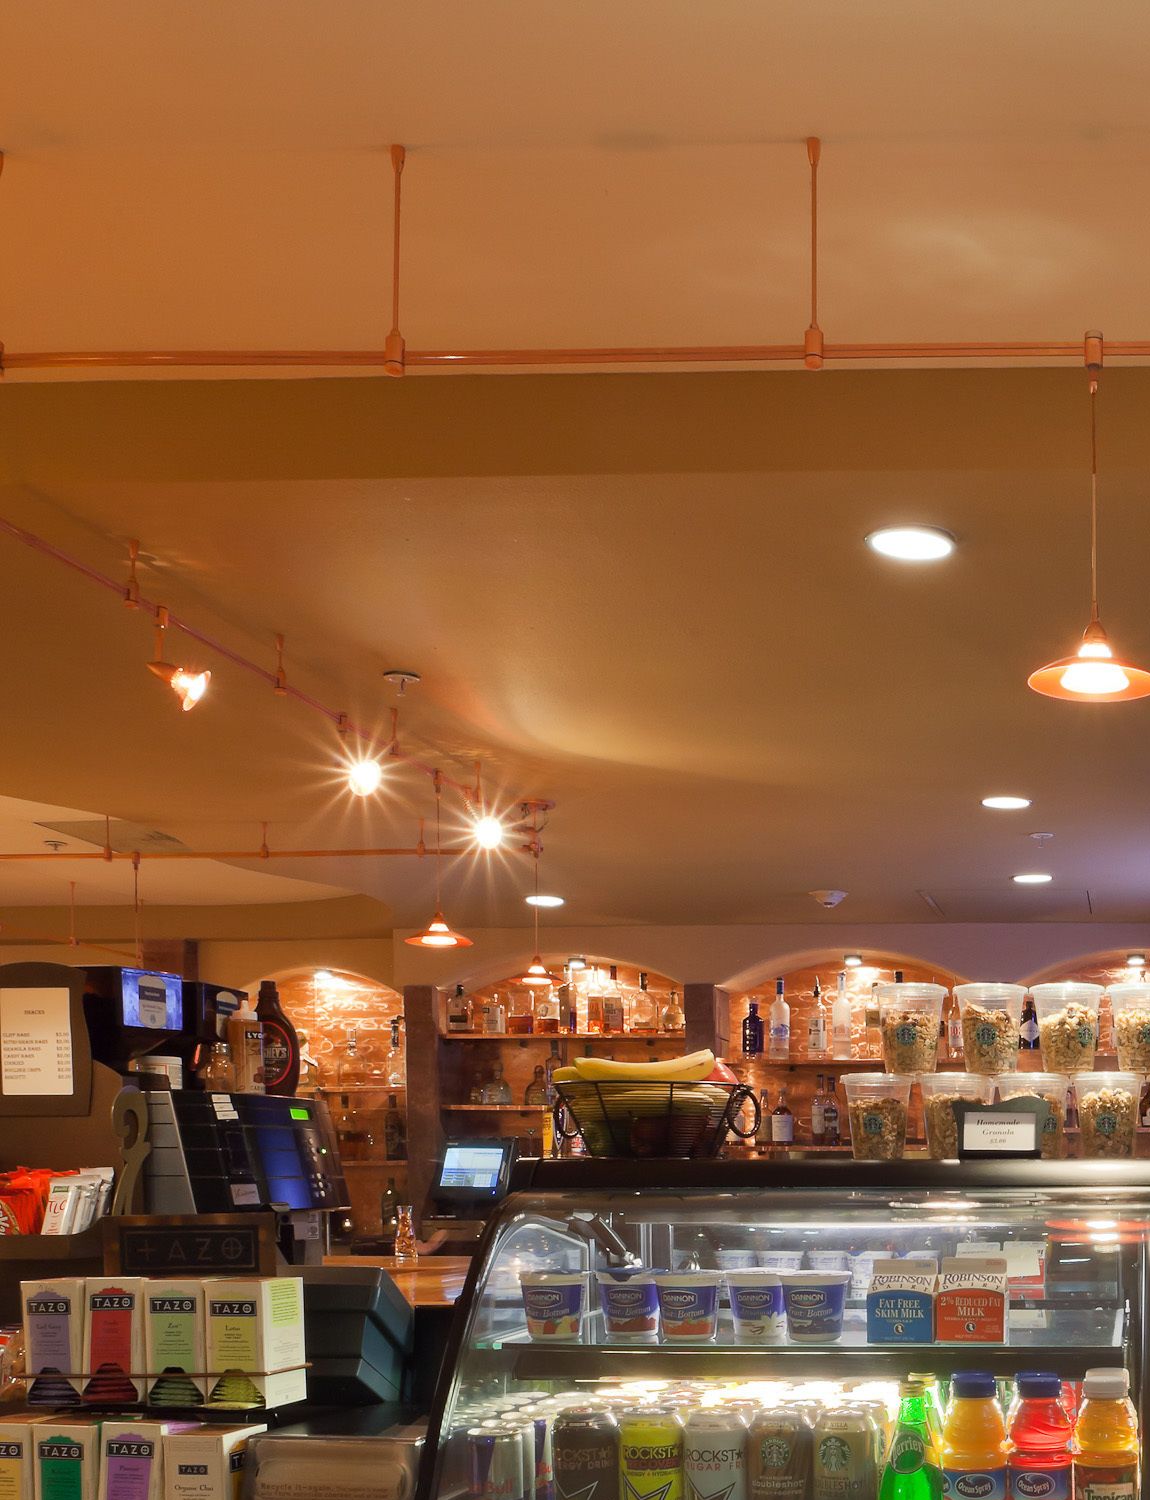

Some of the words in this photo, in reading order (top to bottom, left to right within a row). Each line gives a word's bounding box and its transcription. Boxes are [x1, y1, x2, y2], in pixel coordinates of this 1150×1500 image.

[872, 1275, 932, 1286] ROBINSON
[943, 1273, 1003, 1284] ROBINSON
[872, 1284, 929, 1292] DAIRY
[942, 1282, 1001, 1290] DAIRY
[94, 1297, 130, 1307] TAZO
[663, 1294, 695, 1302] DANNON
[791, 1293, 824, 1301] DANNON
[940, 1297, 954, 1306] 2%
[955, 1297, 988, 1307] REDUCED
[30, 1303, 66, 1313] TAZO
[154, 1301, 192, 1311] TAZO
[879, 1299, 896, 1308] FAT
[898, 1299, 920, 1308] FREE
[214, 1304, 252, 1314] TAZO
[807, 1308, 833, 1318] Bottom
[875, 1309, 898, 1318] SKIM
[901, 1309, 924, 1318] MILK
[957, 1307, 985, 1317] MILK
[42, 1447, 79, 1457] TAZO
[111, 1444, 150, 1455] TAZO
[892, 1438, 923, 1462] Perrier
[729, 1463, 744, 1471] FR
[261, 1483, 292, 1492] Recycle
[958, 1481, 975, 1494] Ocean
[975, 1480, 992, 1495] Spray
[1018, 1480, 1034, 1493] Ocean
[1034, 1479, 1050, 1493] Spray
